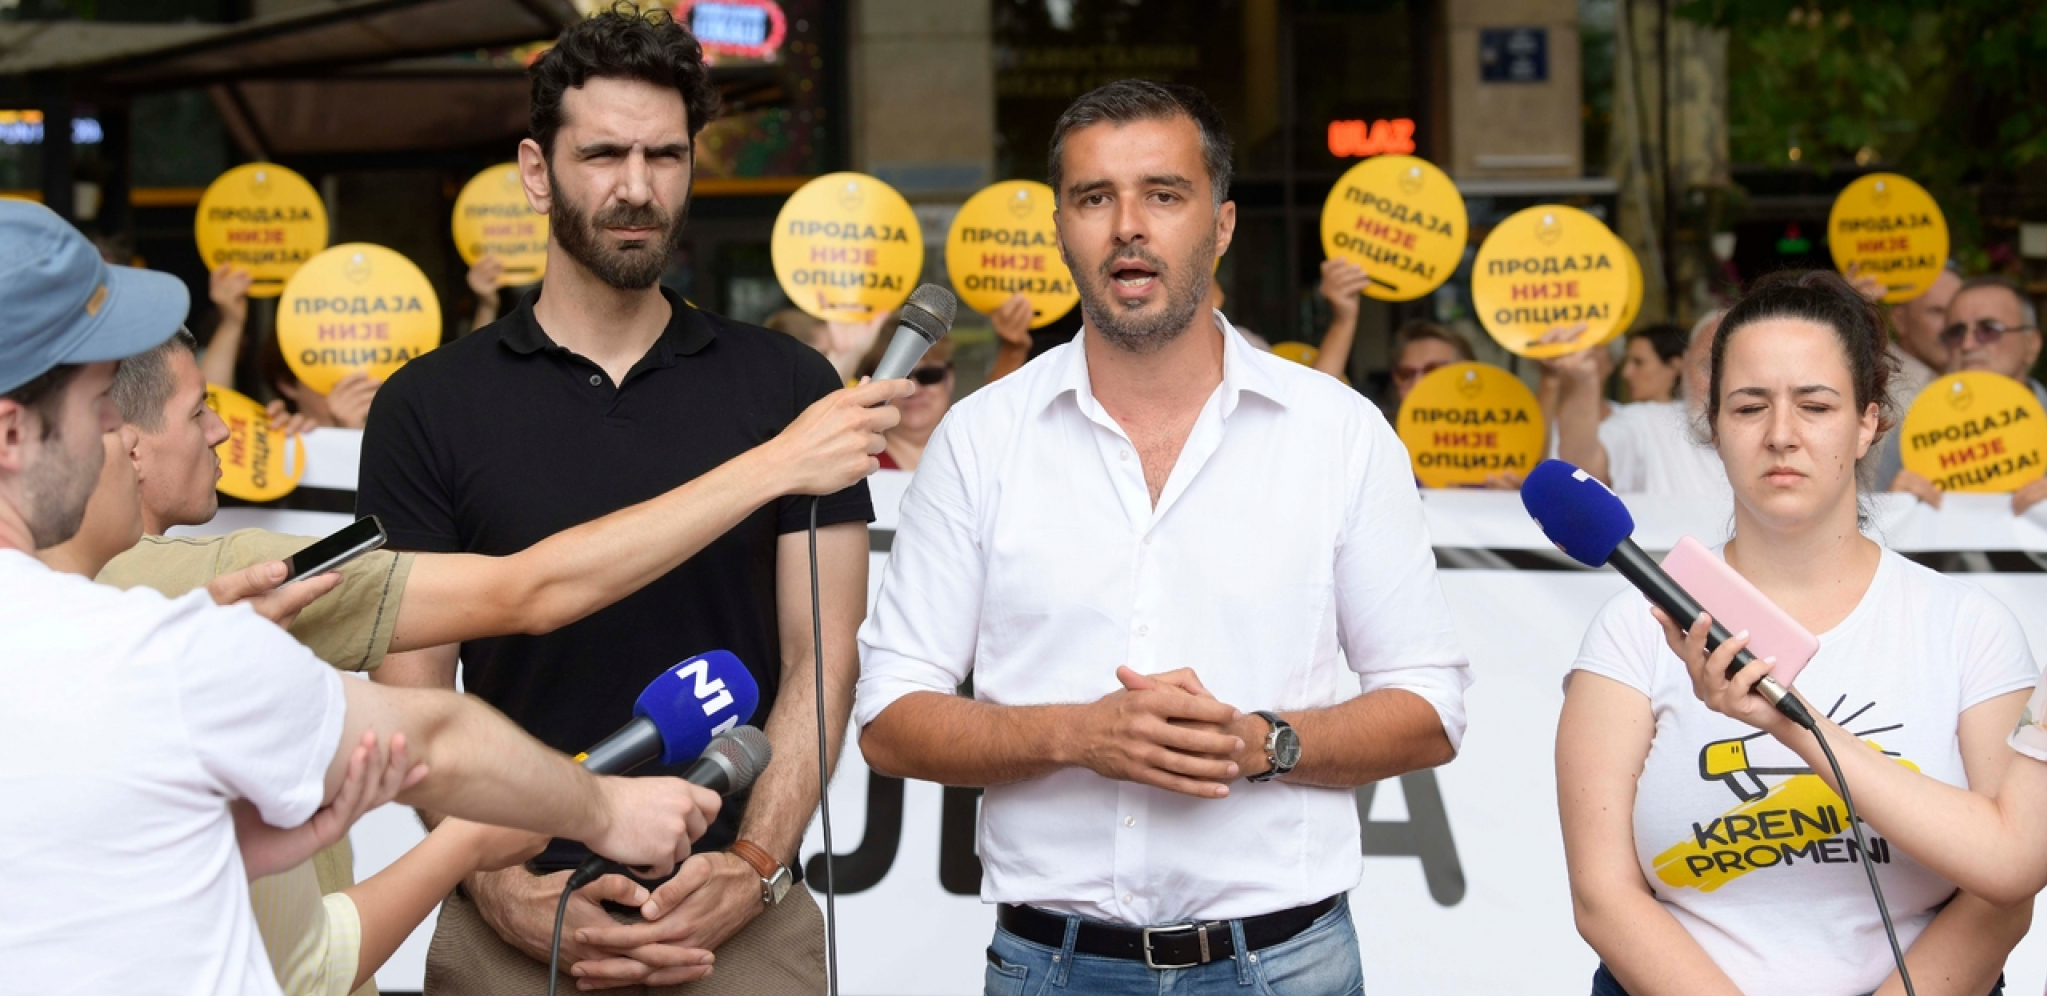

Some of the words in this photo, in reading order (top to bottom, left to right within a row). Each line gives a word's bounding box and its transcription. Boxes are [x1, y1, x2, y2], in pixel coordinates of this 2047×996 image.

[1345, 185, 1453, 238] ПРОДАЈА
[789, 220, 909, 243] ПРОДАЈА
[1355, 215, 1418, 251] НИЈЕ
[810, 245, 877, 267] НИЈЕ
[981, 253, 1045, 272] НИЈЕ
[1333, 232, 1436, 280] ОПЦИЈА!
[1489, 254, 1611, 276] ПРОДАЈА
[792, 268, 904, 292] ОПЦИЈА!
[965, 274, 1073, 295] ОПЦИЈА!
[1512, 280, 1579, 300] НИЈЕ
[294, 296, 423, 315] ПРОДАЈА
[1495, 303, 1609, 325] ОПЦИЈА!
[318, 322, 390, 341] НИЈЕ
[1412, 408, 1529, 426] ПРОДАЈА
[1433, 431, 1498, 448] НИЈЕ
[1911, 406, 2030, 451] ПРОДАЈА
[1417, 452, 1527, 471] ОПЦИЈА!
[1939, 437, 2006, 470] НИЈЕ
[675, 659, 734, 716] N1
[1686, 836, 1890, 877] PROMENI
